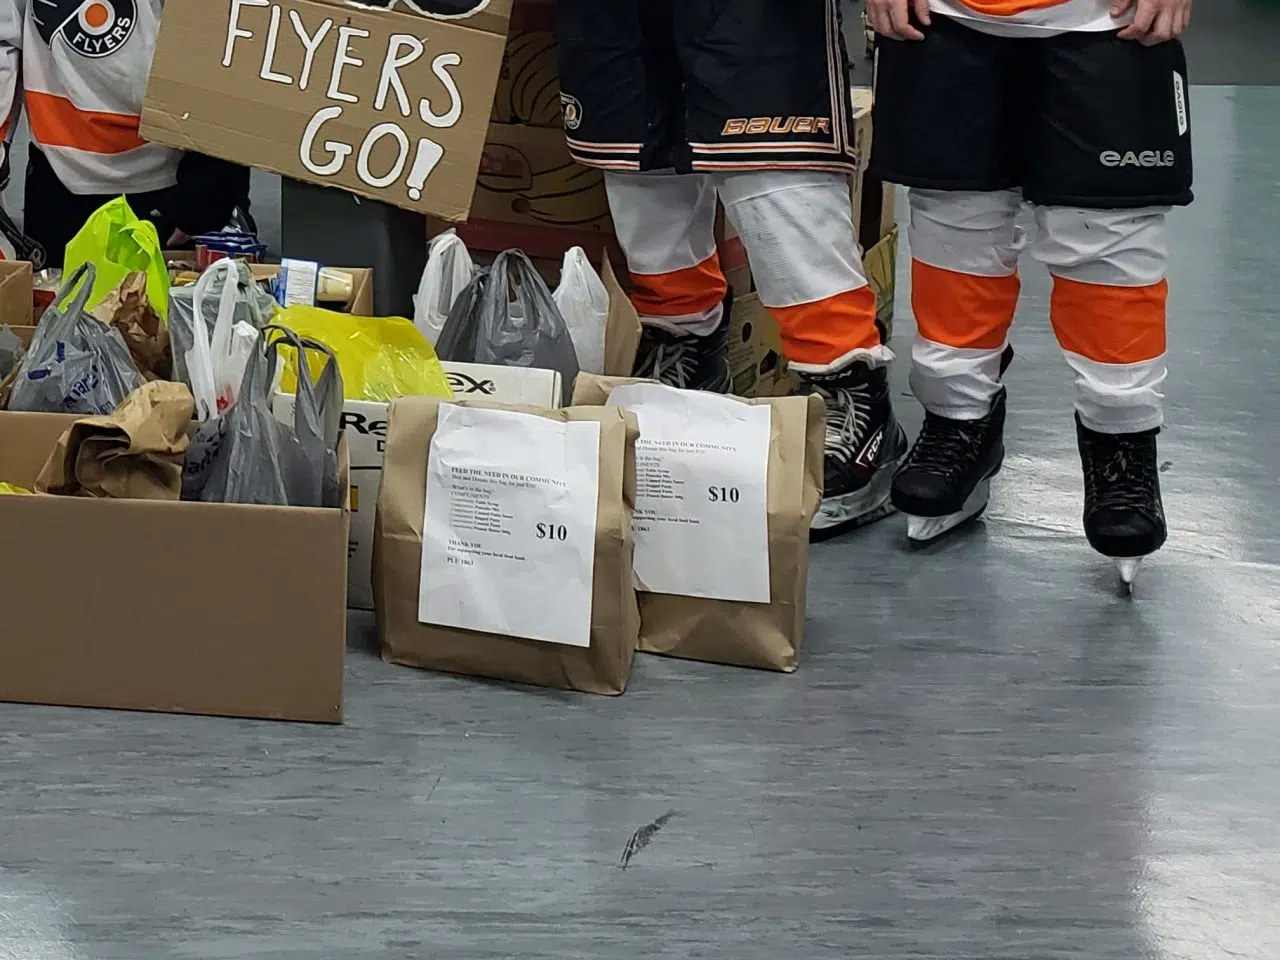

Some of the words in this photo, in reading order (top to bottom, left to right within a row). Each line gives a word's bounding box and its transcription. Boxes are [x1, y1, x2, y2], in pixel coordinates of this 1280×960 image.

[72, 16, 131, 54] FLYERS
[299, 106, 445, 201] GO!
[867, 430, 883, 462] CCM
[708, 486, 740, 503] $10
[535, 522, 568, 542] $10
